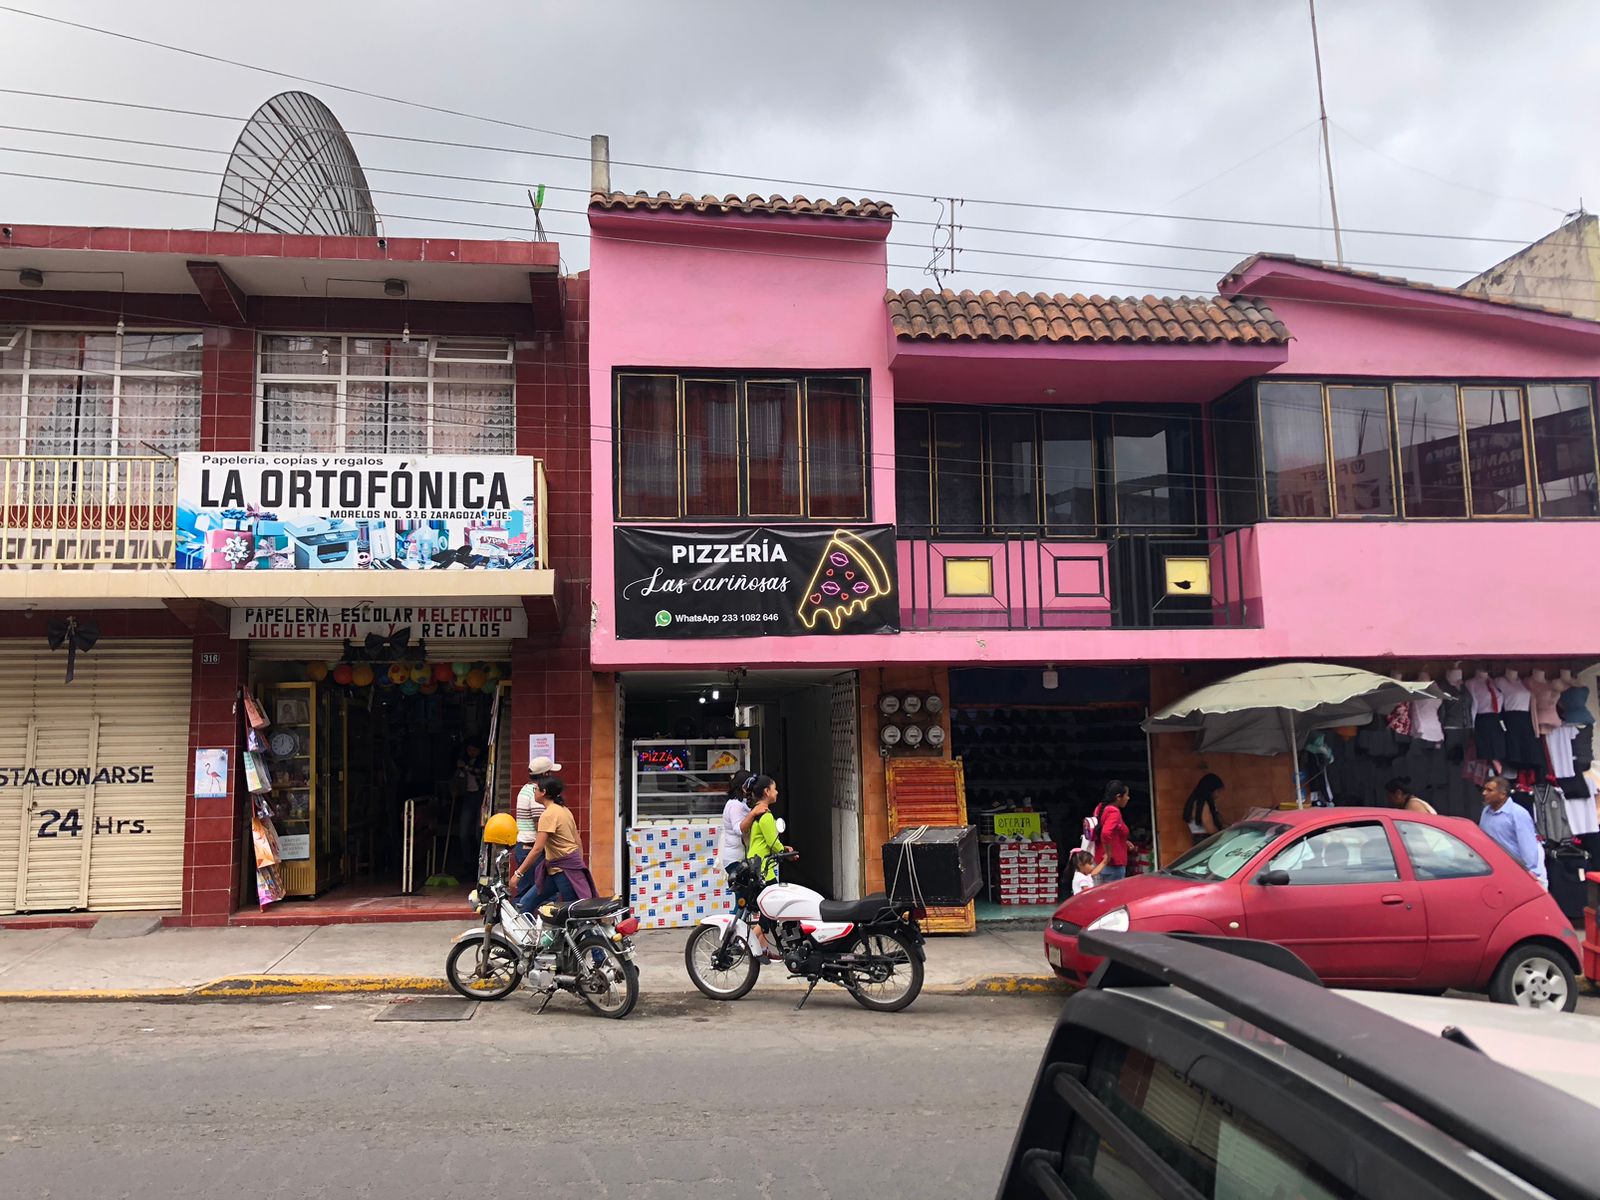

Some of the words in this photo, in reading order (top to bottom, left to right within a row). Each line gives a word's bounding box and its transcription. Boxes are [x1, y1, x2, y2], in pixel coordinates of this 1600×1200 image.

[322, 459, 330, 467] y
[334, 457, 384, 467] regalos
[200, 469, 245, 508] LA
[260, 462, 510, 509] ORTOFÓNICA
[330, 510, 380, 519] MORELOS
[384, 510, 402, 519] NO.
[672, 539, 788, 564] PIZZERÍA
[623, 567, 687, 600] Las
[692, 574, 791, 593] cariñosas
[245, 608, 329, 623] PAPELERIA
[341, 607, 413, 623] ESCOLAR
[675, 614, 720, 624] WhatsApp
[722, 614, 739, 622] 233
[740, 614, 761, 622] 1082
[763, 613, 779, 622] 646
[248, 623, 357, 638] JUGUETERIA
[421, 623, 500, 638] REGALOS
[203, 654, 218, 663] 316
[642, 752, 673, 763] PIZZA
[36, 808, 83, 838] 24
[95, 815, 152, 835] Hrs.
